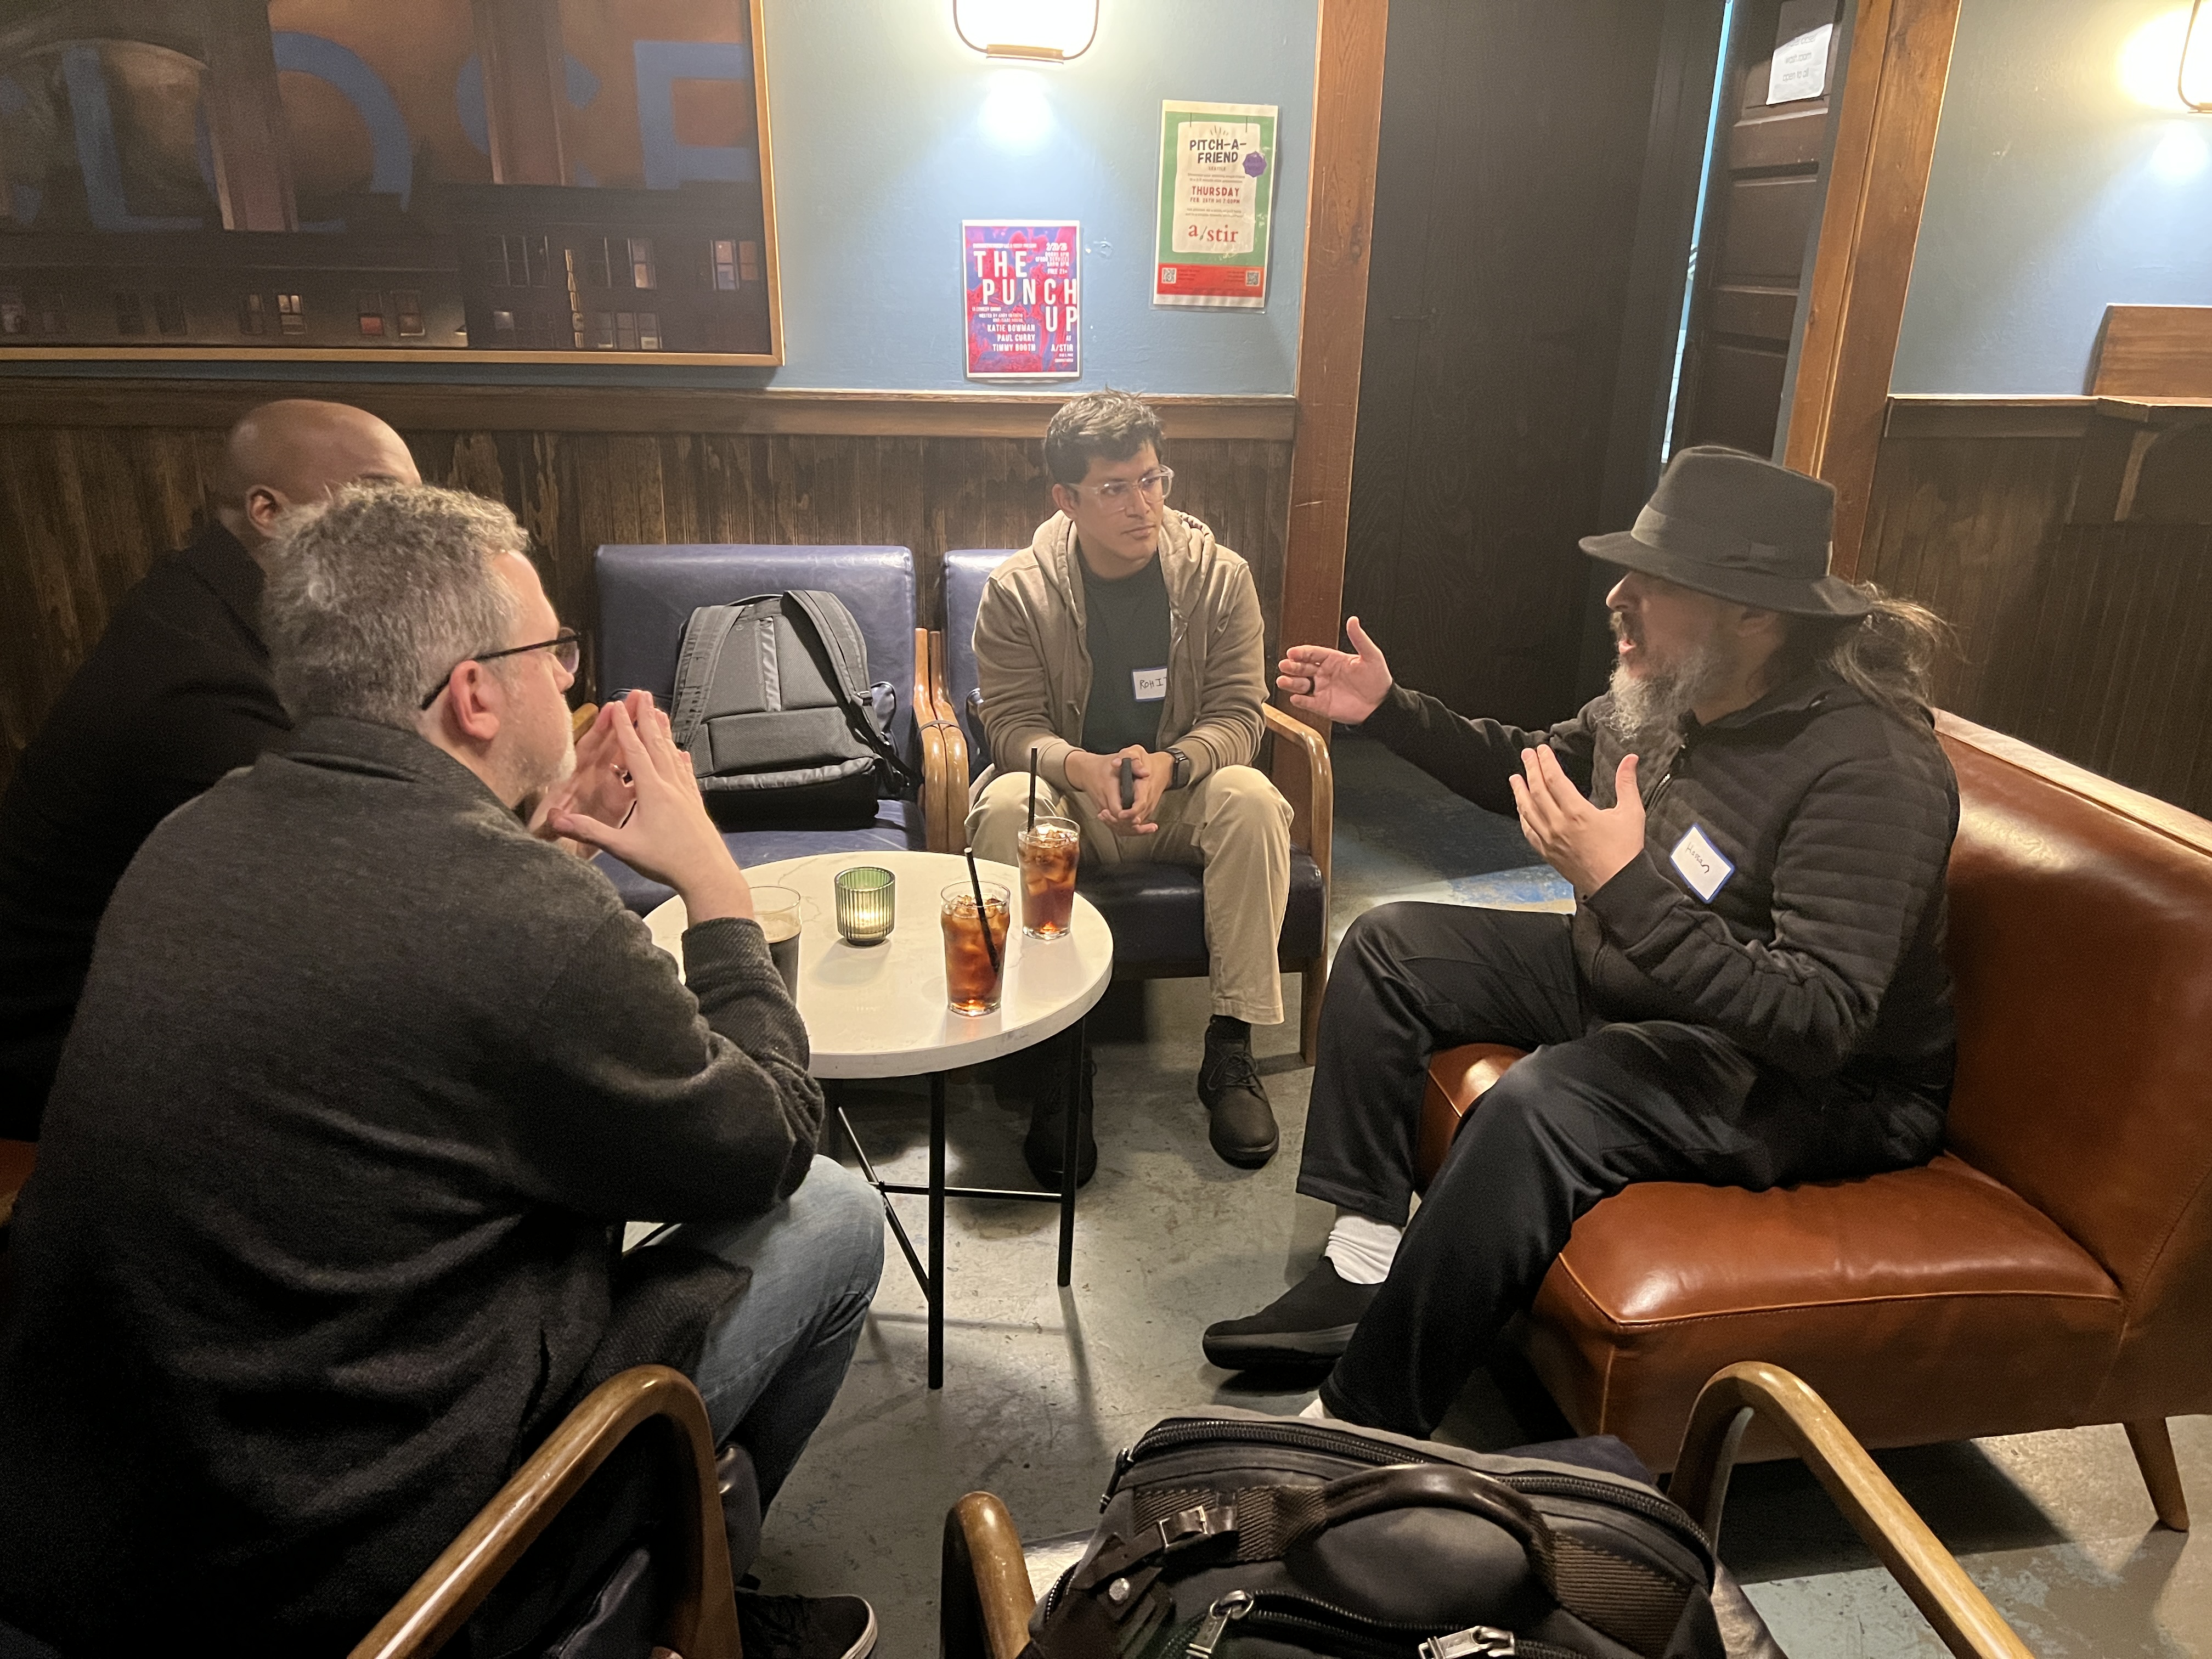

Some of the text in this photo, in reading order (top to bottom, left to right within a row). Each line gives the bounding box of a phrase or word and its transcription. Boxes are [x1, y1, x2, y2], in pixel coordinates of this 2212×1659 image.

[1189, 138, 1246, 151] PITCH-A-
[1198, 151, 1238, 163] FRIEND
[1192, 186, 1239, 196] THURSDAY
[1188, 224, 1238, 242] a/stir
[973, 251, 1028, 278] THE
[982, 279, 1077, 305] PUNCH
[1045, 306, 1077, 332] UP
[997, 334, 1035, 342] PAUL CURRY
[992, 343, 1036, 352] TIMMY BOOTH
[1051, 343, 1073, 352] A/STIR
